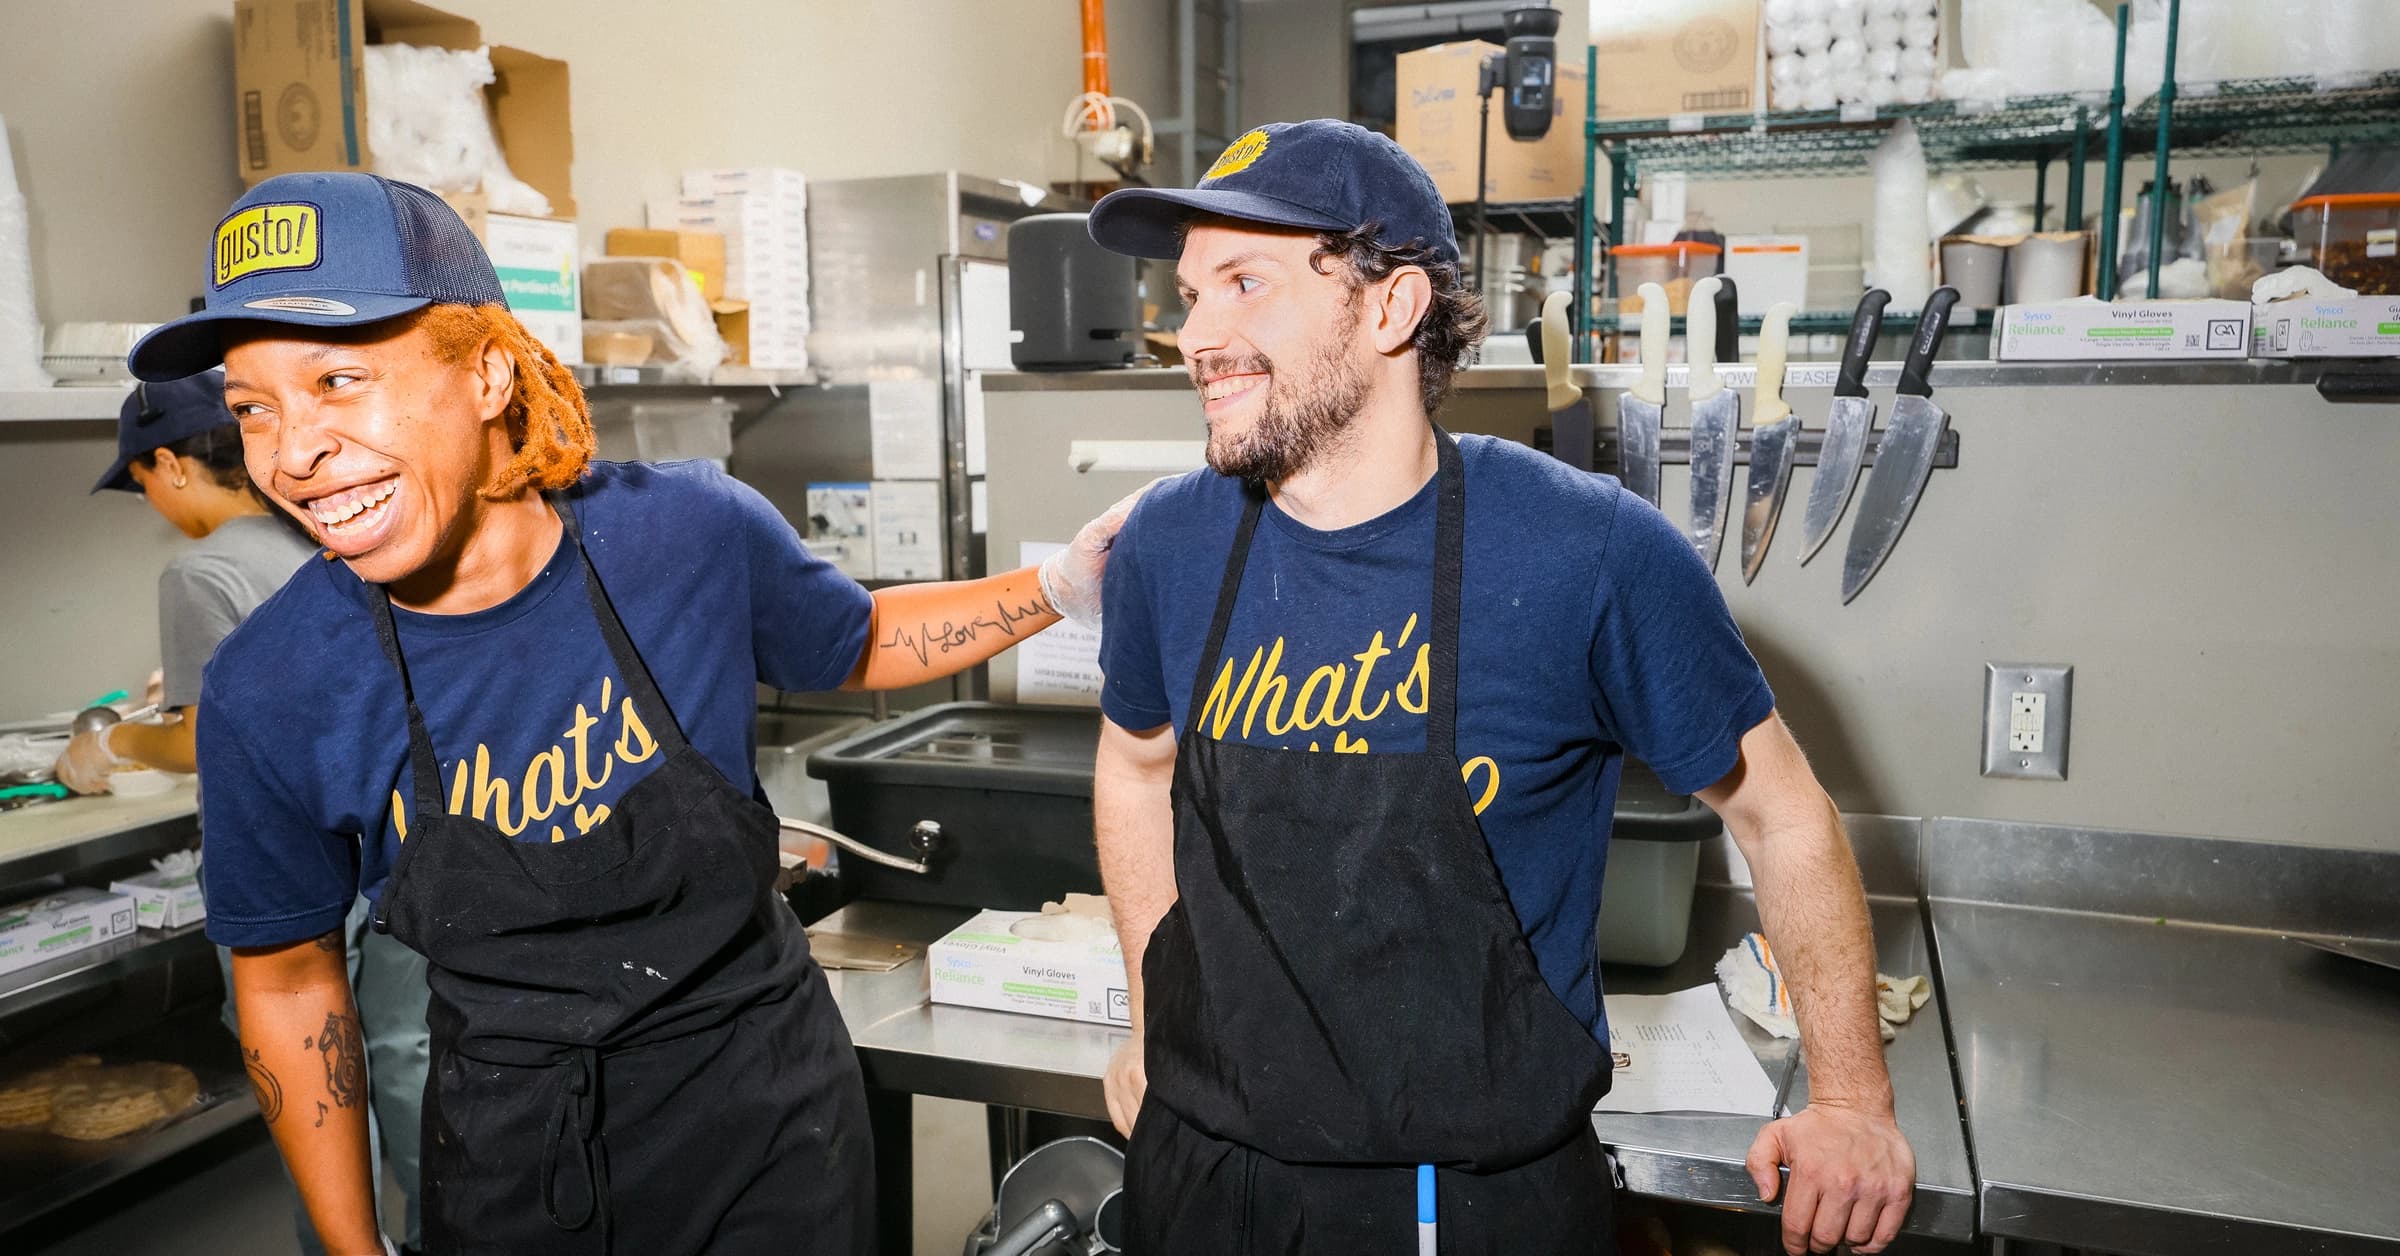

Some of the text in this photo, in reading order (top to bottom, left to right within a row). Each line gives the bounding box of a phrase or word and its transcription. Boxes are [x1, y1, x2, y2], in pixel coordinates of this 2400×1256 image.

[221, 208, 308, 280] gusto!
[2023, 311, 2052, 322] Sysco
[2112, 309, 2173, 320] Vinyl Gloves
[2315, 305, 2344, 316] Sysco
[2008, 323, 2065, 335] Reliance
[2300, 317, 2358, 329] Reliance
[1791, 370, 1838, 385] EASE
[1197, 612, 1430, 741] What's
[934, 967, 985, 986] Reliance
[1022, 965, 1045, 977] Vinyl
[1046, 968, 1076, 981] Gloves
